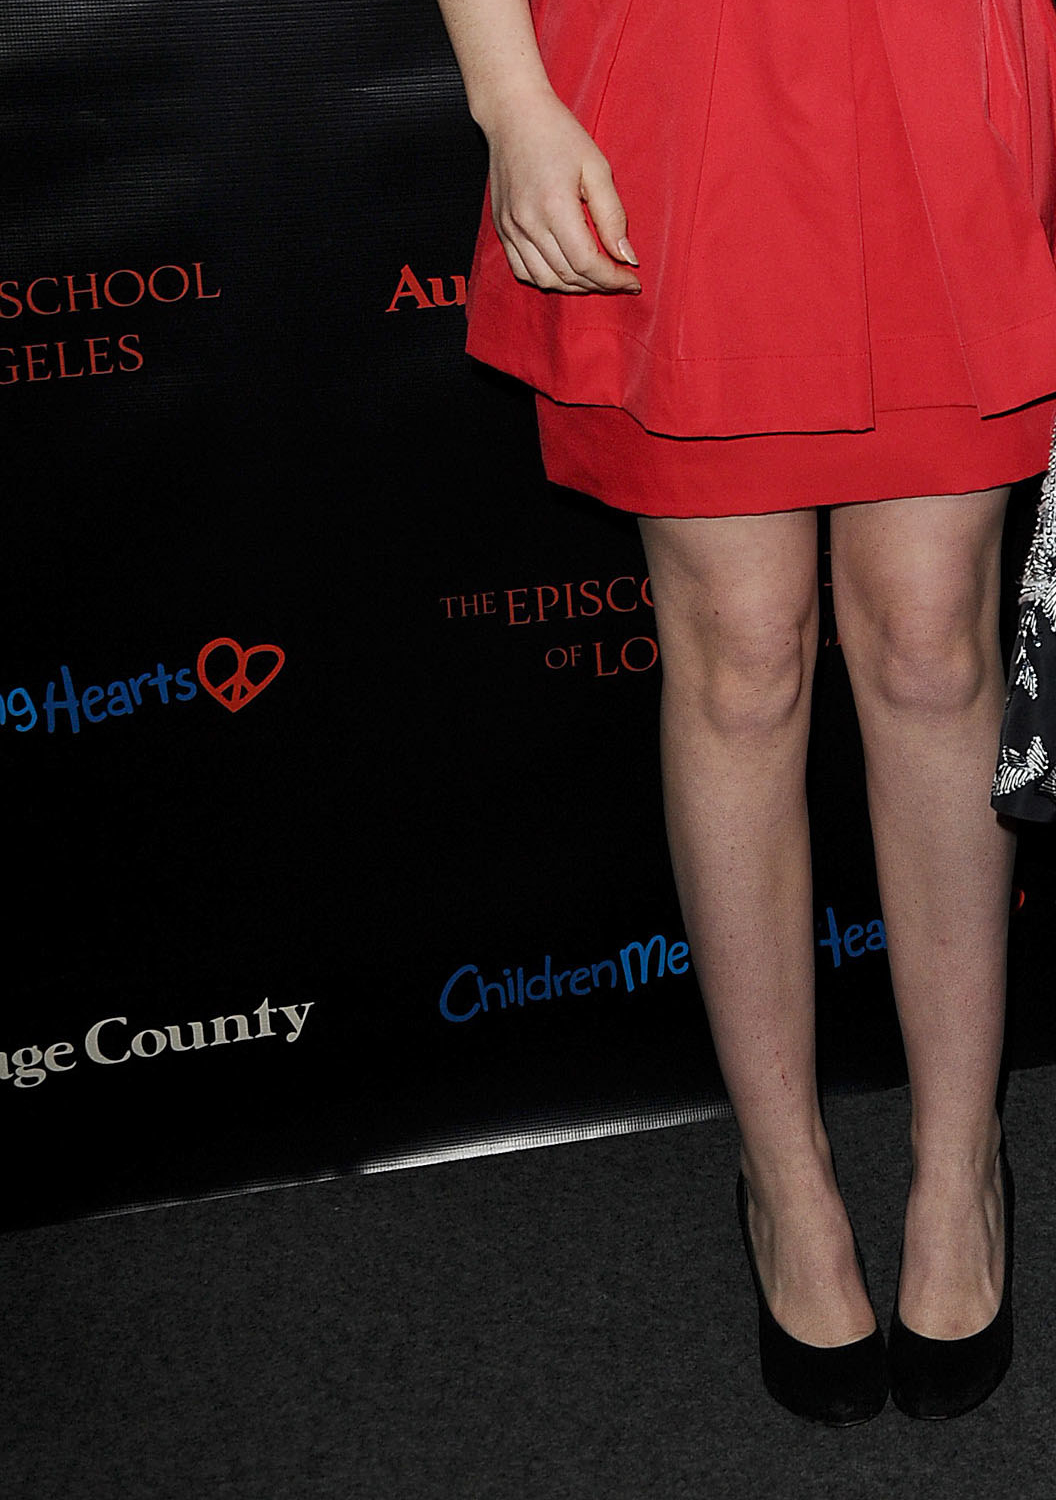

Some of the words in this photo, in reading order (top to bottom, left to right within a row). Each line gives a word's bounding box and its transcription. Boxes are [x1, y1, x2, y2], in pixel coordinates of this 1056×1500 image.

[439, 591, 497, 620] THE
[544, 644, 582, 670] OF
[592, 636, 659, 678] LO
[43, 664, 198, 734] Hearts
[437, 953, 619, 1024] Children
[85, 996, 315, 1065] County
